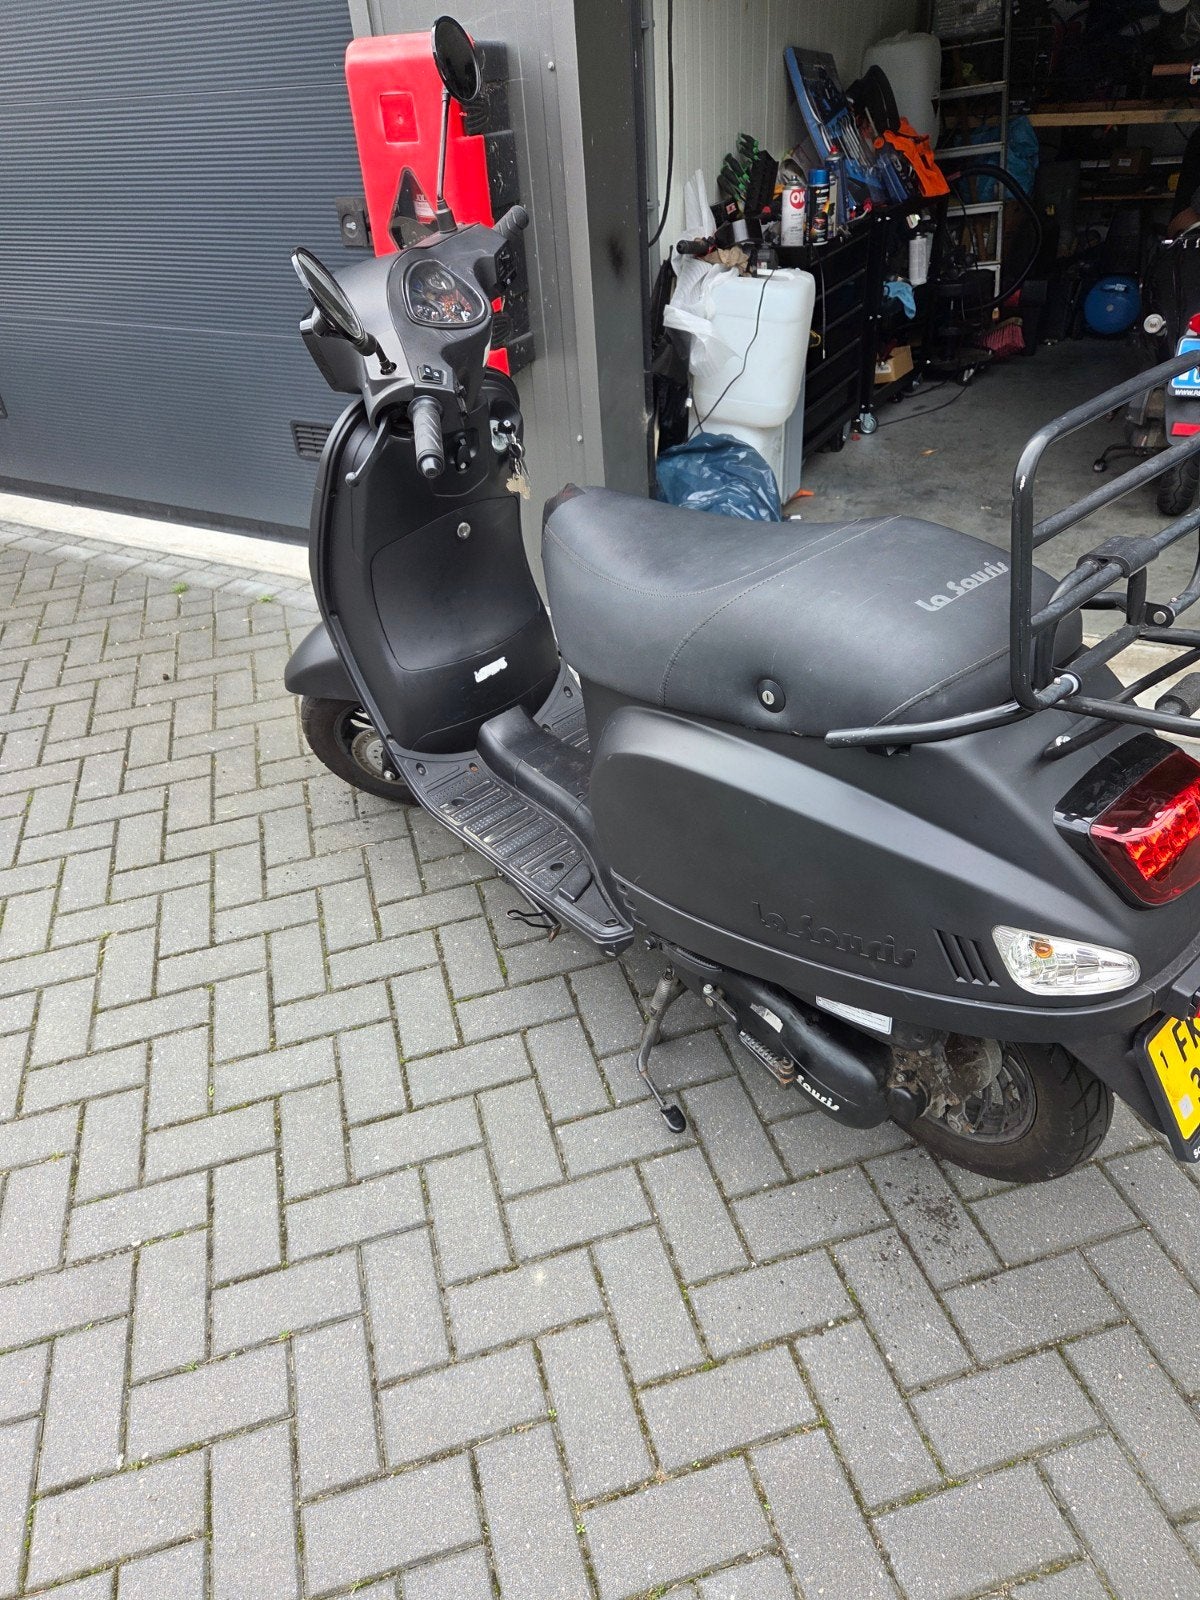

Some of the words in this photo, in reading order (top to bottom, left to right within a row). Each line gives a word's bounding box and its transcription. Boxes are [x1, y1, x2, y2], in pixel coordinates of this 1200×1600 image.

[946, 561, 1010, 596] Souris
[800, 914, 918, 968] Souris
[796, 1074, 840, 1112] Souris
